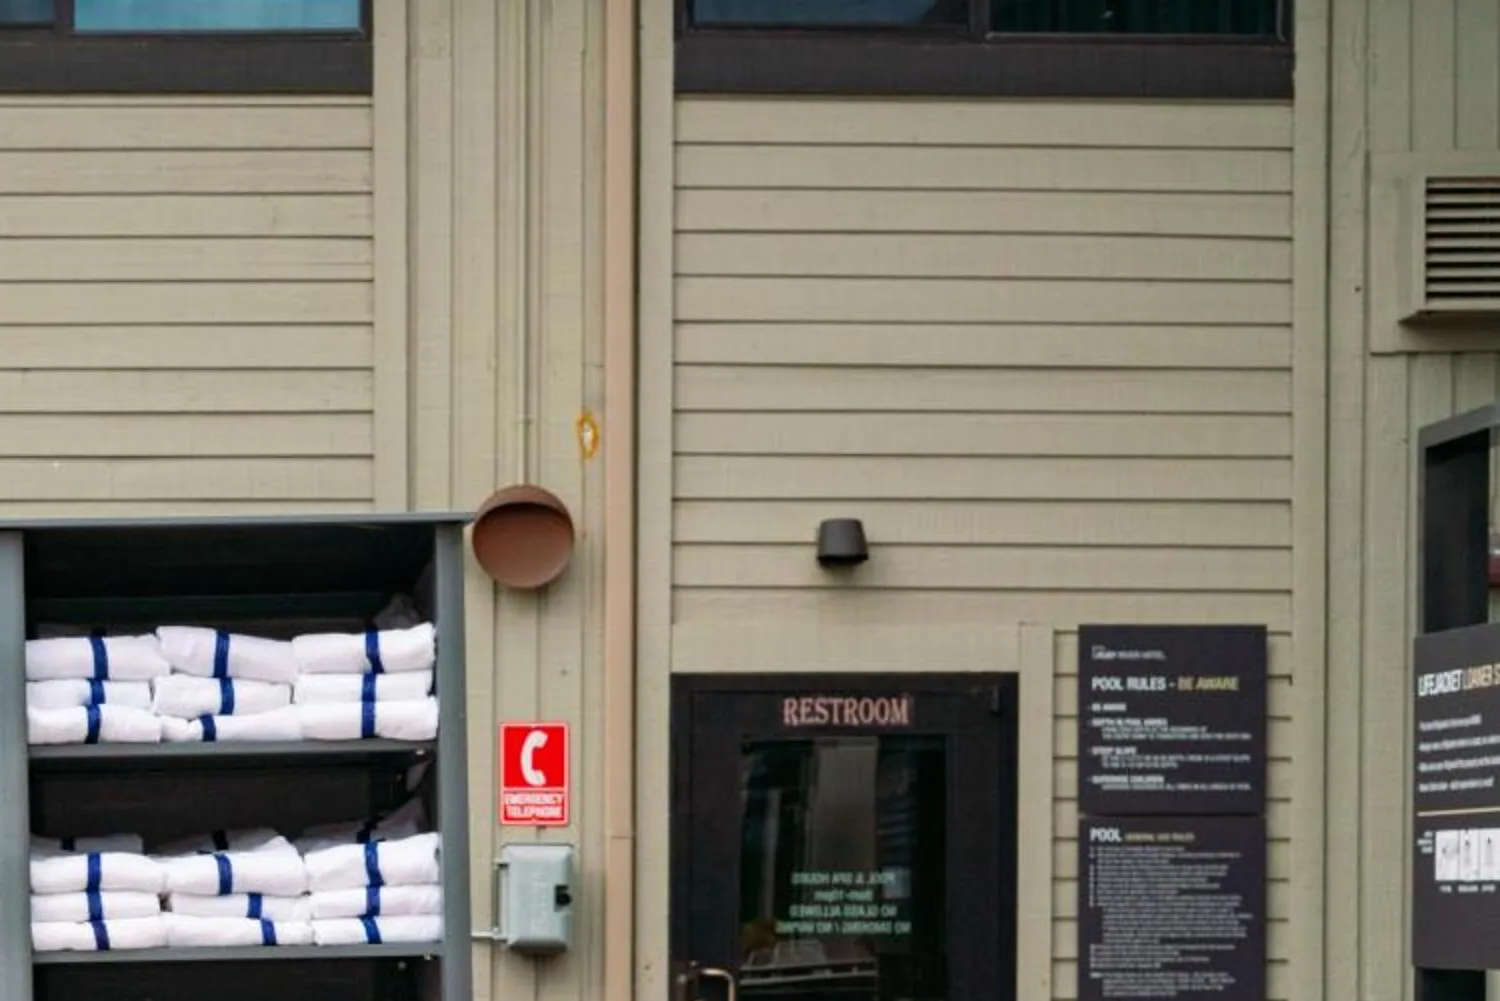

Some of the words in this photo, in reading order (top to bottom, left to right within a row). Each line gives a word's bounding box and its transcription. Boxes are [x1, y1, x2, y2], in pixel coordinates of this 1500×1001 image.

[1092, 676, 1124, 691] POOL
[1126, 676, 1166, 691] RULES
[1196, 676, 1239, 691] AWARE
[783, 697, 908, 725] RESTROOM
[507, 805, 562, 818] TELEPHONE
[1089, 828, 1122, 842] POOL
